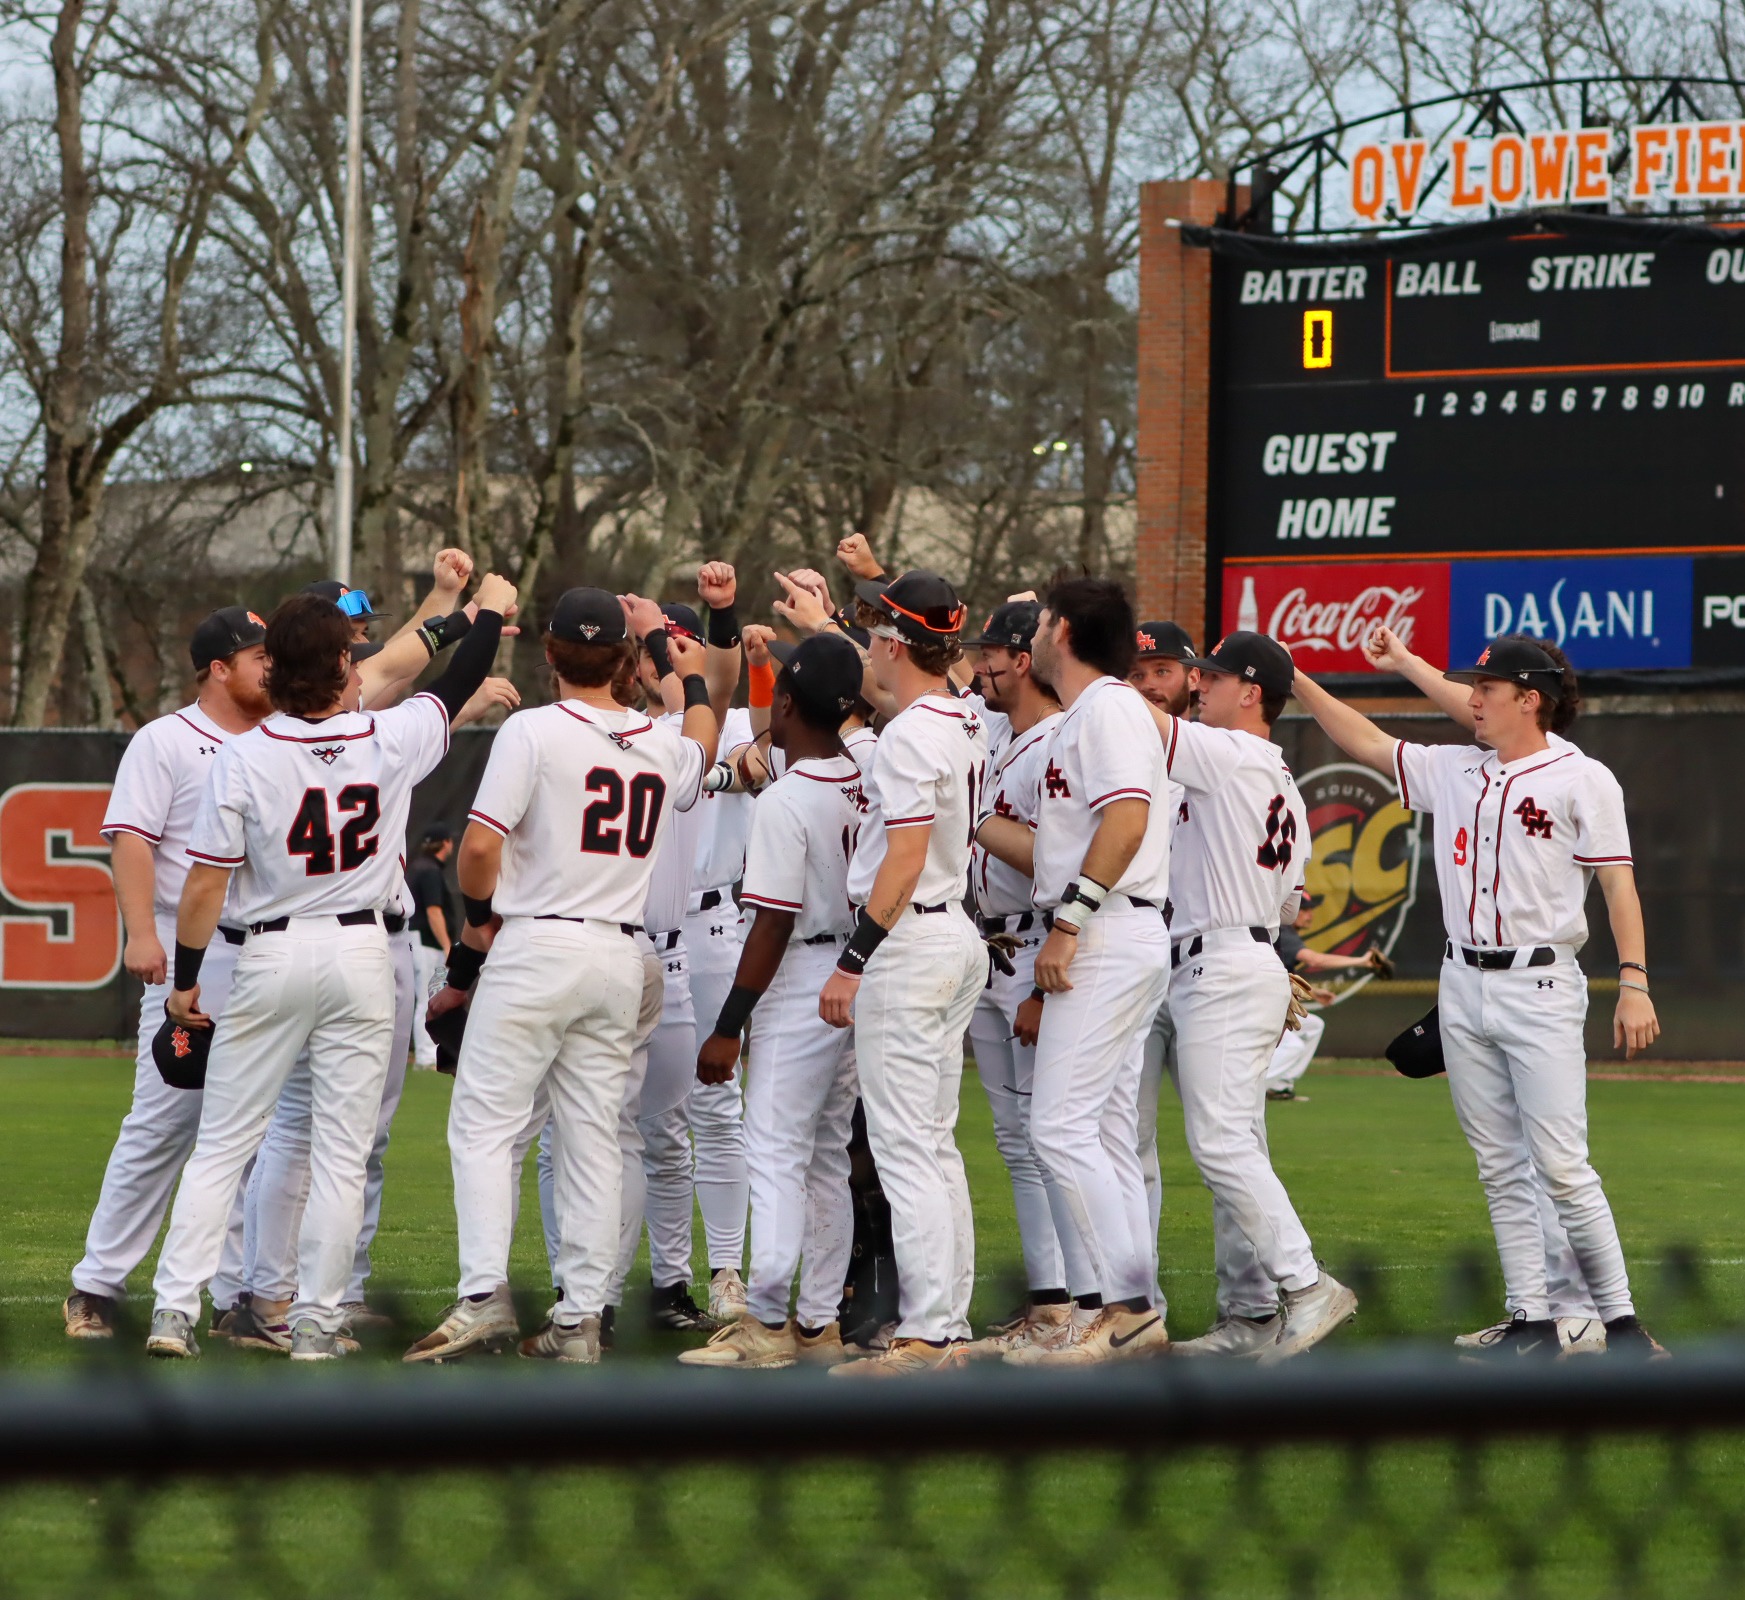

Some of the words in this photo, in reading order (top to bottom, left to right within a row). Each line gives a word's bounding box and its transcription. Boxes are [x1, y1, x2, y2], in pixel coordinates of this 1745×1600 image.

[1351, 141, 1427, 223] QV
[1450, 131, 1610, 209] LOWE
[1632, 122, 1745, 198] FIE
[1240, 265, 1367, 304] BATTER
[1395, 260, 1482, 297] BALL
[1527, 252, 1655, 292] STRIKE
[1302, 309, 1334, 369] 0
[1414, 393, 1425, 417] 1
[1441, 392, 1459, 416] 2
[1470, 390, 1487, 415] 3
[1500, 390, 1517, 414] 4
[1530, 389, 1547, 413] 5
[1560, 387, 1577, 412] 6
[1592, 386, 1607, 411] 7
[1621, 385, 1639, 410] 8
[1652, 384, 1669, 409] 9
[1678, 383, 1705, 408] 10
[1262, 431, 1397, 476] GUEST
[1276, 496, 1396, 539] HOME
[1484, 577, 1653, 647] DASANI
[580, 765, 667, 859] 20
[1315, 784, 1375, 807] SOUTH
[286, 783, 380, 877] 42
[1453, 827, 1468, 867] 9
